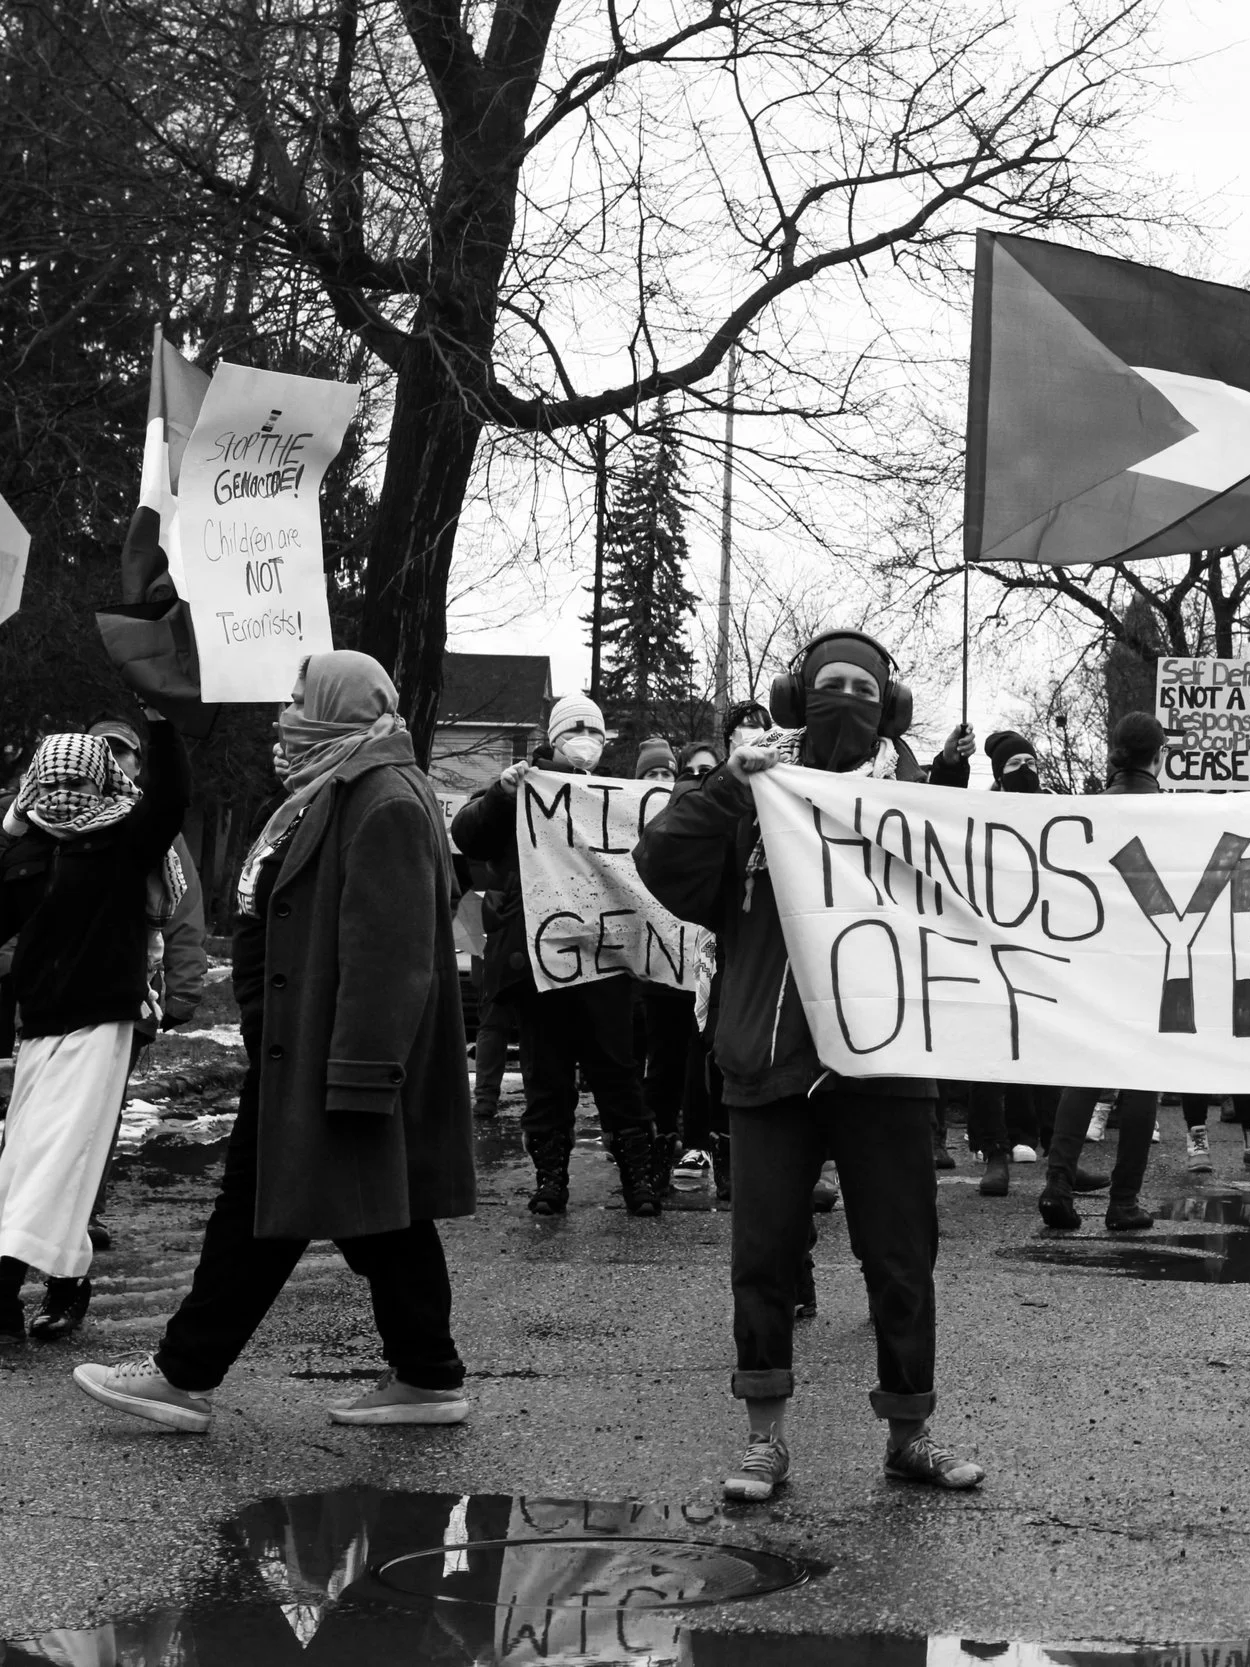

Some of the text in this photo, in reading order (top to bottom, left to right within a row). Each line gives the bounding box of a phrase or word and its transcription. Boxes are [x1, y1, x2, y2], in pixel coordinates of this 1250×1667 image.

[258, 432, 314, 467] THE
[214, 463, 305, 505] GENOCIDE!
[204, 518, 302, 562] Children are
[245, 556, 285, 596] NOT
[216, 608, 303, 645] Terrorists!
[1162, 659, 1207, 686] Self
[1159, 686, 1177, 709] IS
[1178, 685, 1223, 710] NOT
[1226, 687, 1246, 711] A
[1165, 750, 1250, 781] CEASE
[525, 782, 674, 855] MIC
[804, 796, 1106, 942] HANDS
[534, 909, 686, 986] GEN
[830, 918, 1072, 1062] OFF
